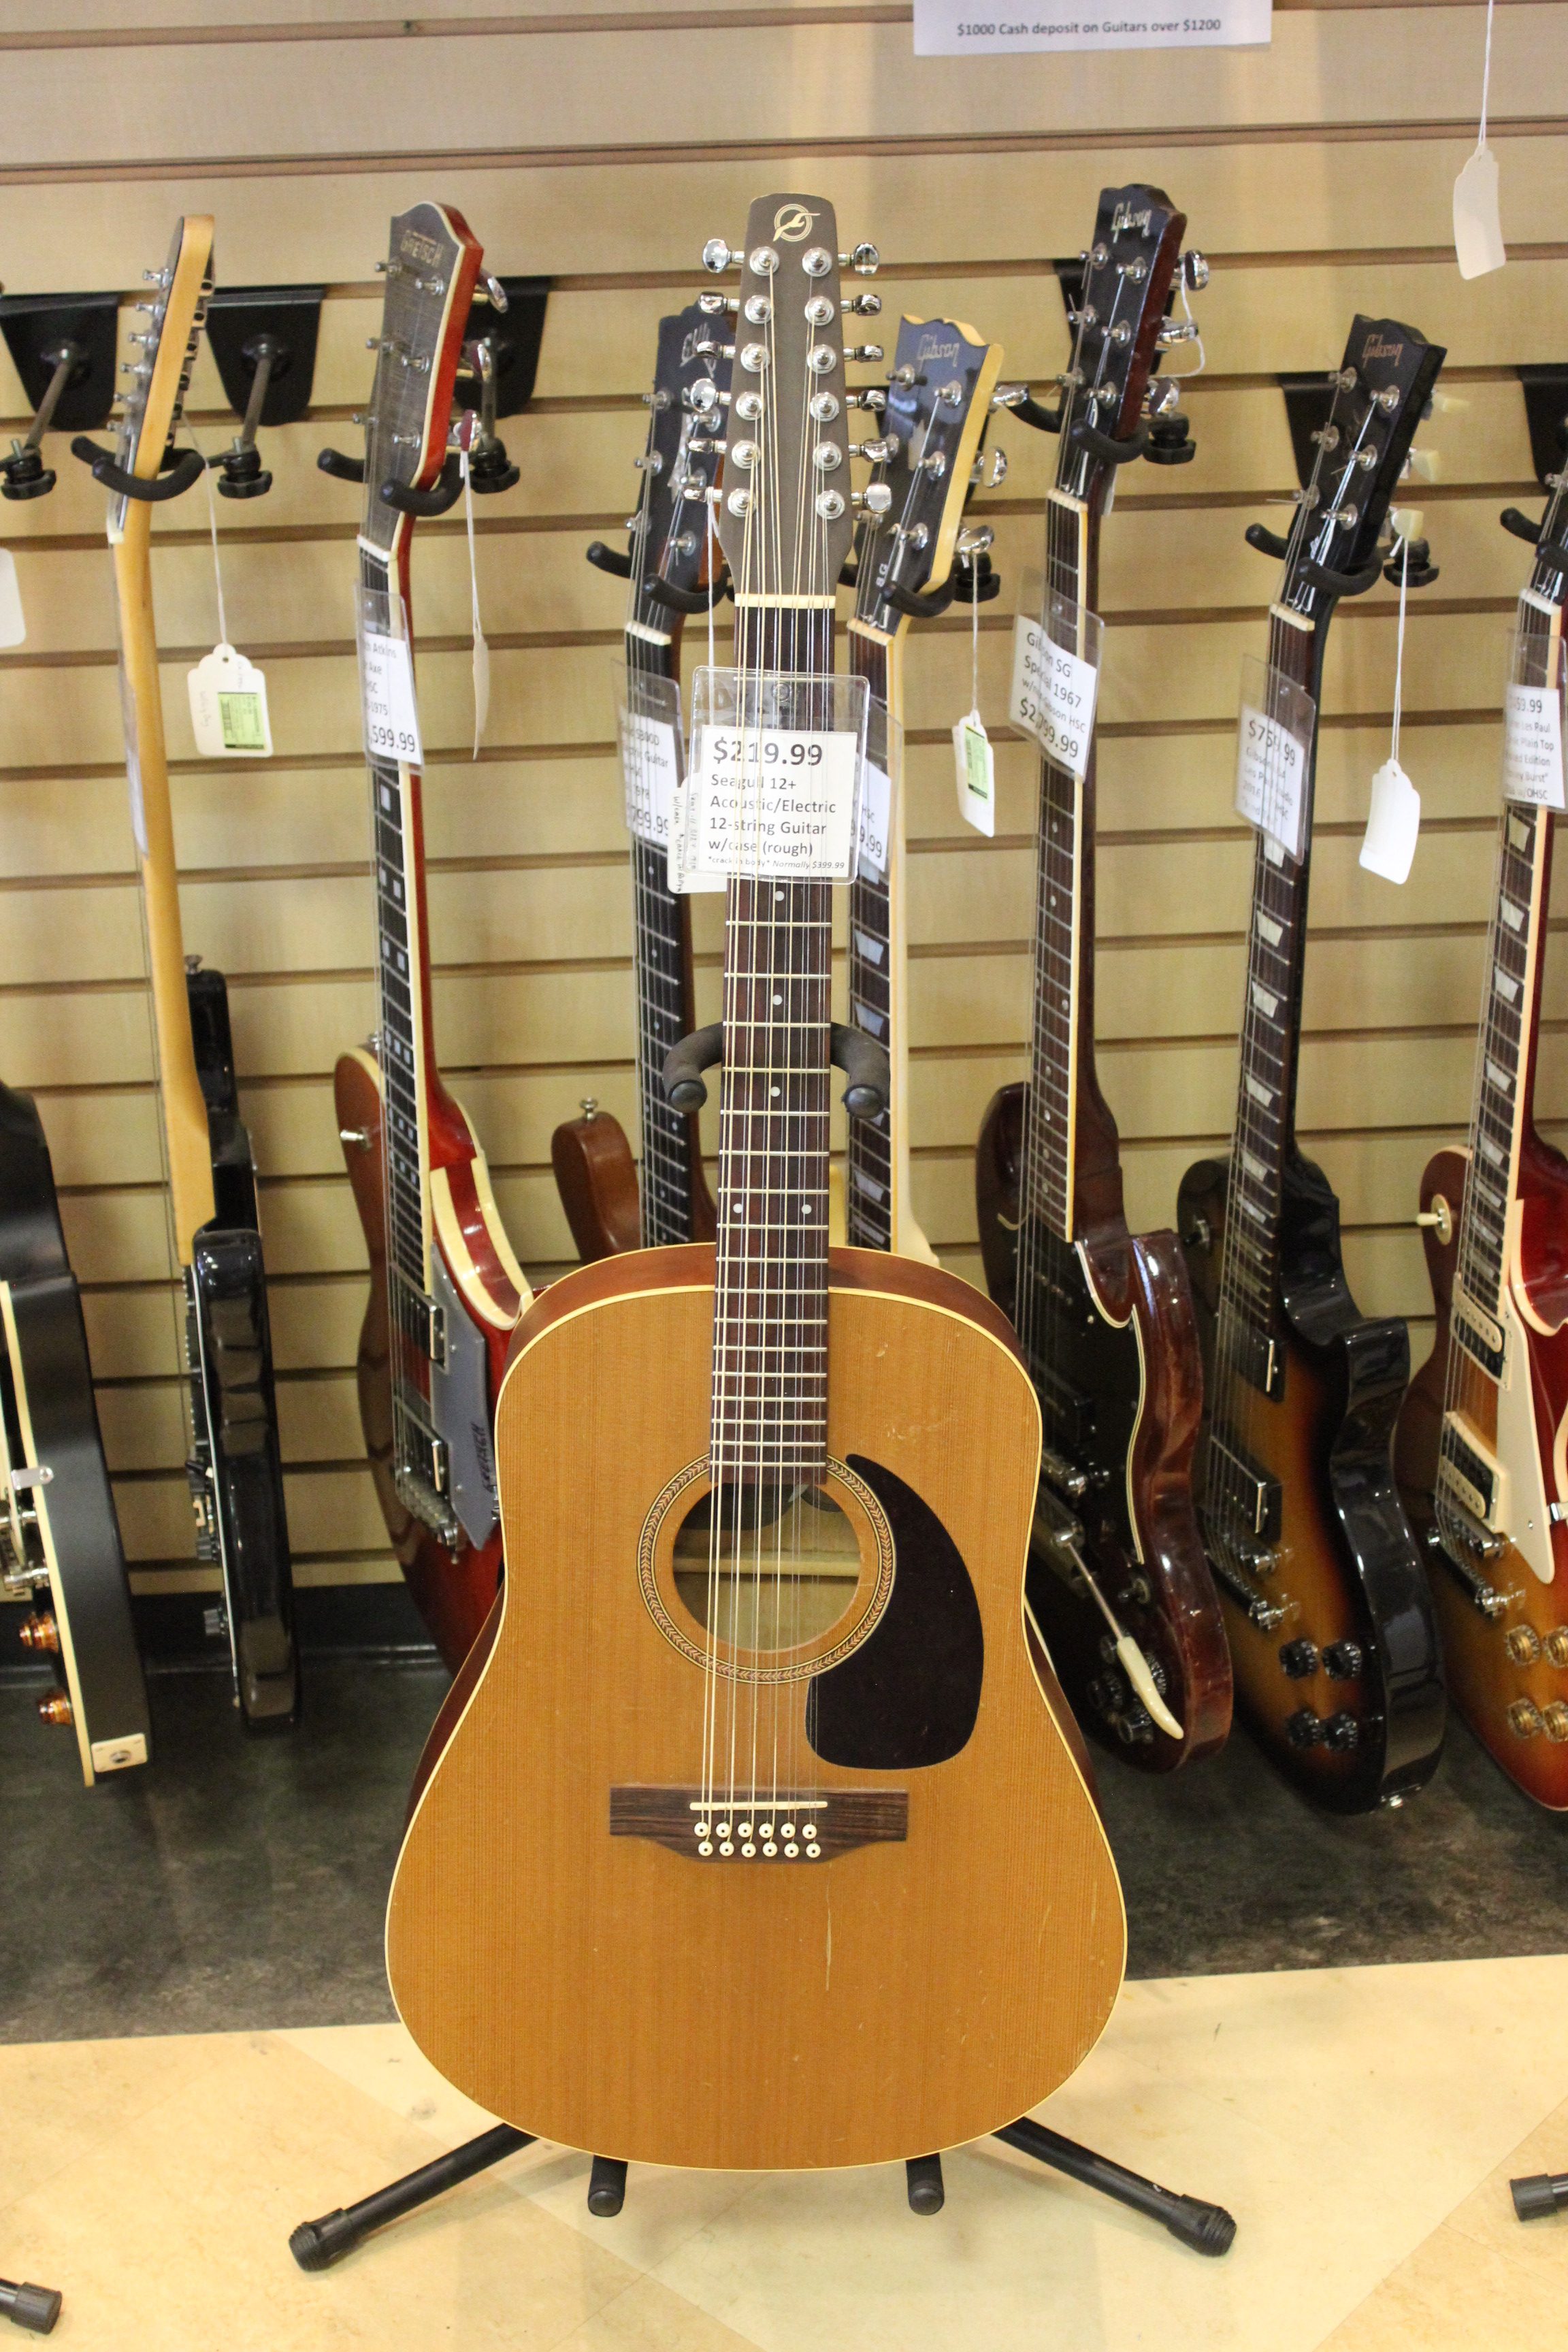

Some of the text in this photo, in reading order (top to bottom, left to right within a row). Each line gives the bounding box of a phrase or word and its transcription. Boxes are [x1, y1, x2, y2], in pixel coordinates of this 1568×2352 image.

[957, 19, 1222, 37] $1000 Cash deposit on Guitars over $1200
[1056, 659, 1071, 678] SG
[1054, 683, 1082, 708] 1967
[713, 736, 823, 766] $219.99
[1540, 739, 1554, 752] Top
[770, 777, 797, 790] 12+
[709, 817, 827, 836] 12-string Guitar
[708, 837, 813, 857] w/case (rough)
[772, 860, 810, 870] Normally
[812, 860, 845, 869] $399.99
